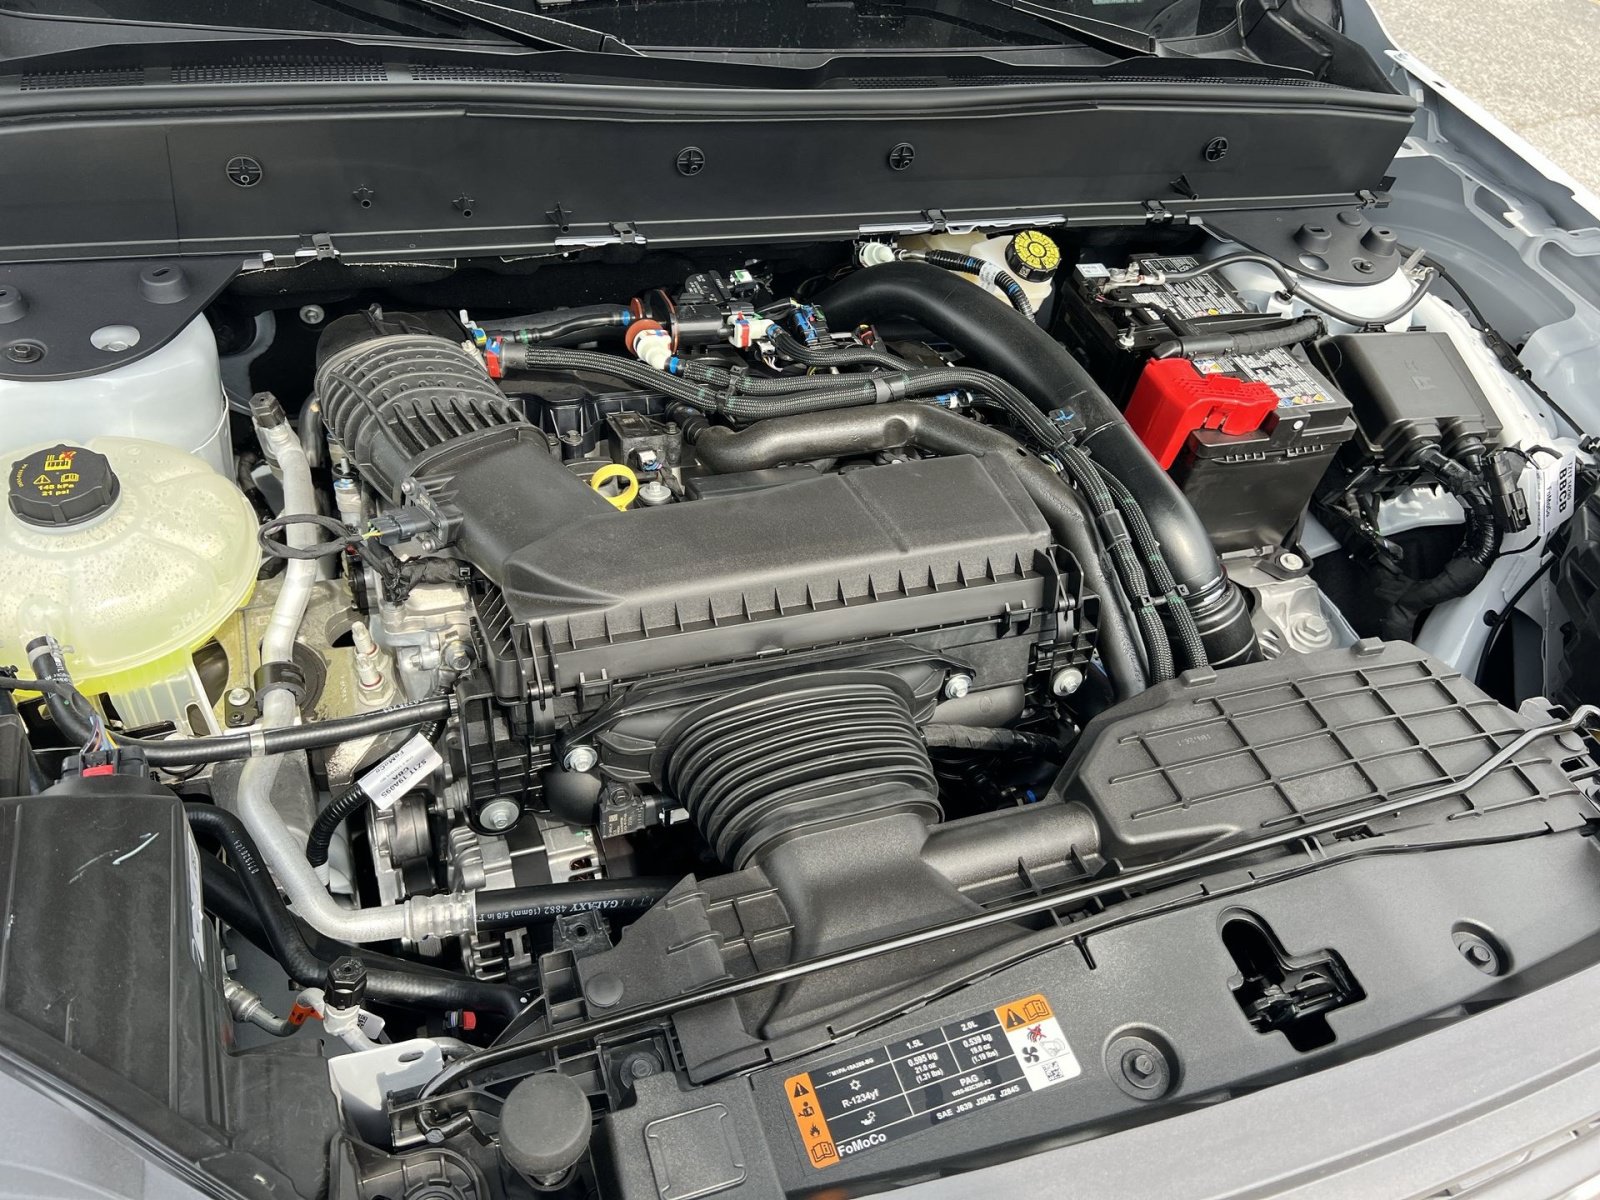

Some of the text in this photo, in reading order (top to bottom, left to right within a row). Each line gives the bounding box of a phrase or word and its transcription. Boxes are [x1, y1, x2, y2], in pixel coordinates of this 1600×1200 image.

[1558, 468, 1568, 514] BBCB
[375, 750, 404, 774] FoMoCo
[544, 905, 567, 914] 4882
[570, 900, 618, 912] GALAXY
[497, 911, 509, 920] 5/8
[511, 908, 541, 917] (16mm)
[960, 1020, 978, 1031] 2.0L
[906, 1039, 924, 1049] 1.5L
[962, 1033, 993, 1048] 0.539 kg
[907, 1052, 938, 1067] 0.595 kg
[986, 1049, 998, 1058] lbs)
[914, 1064, 928, 1074] 21.0
[916, 1068, 944, 1084] (1.31 lbs)
[960, 1074, 979, 1086] PAG
[842, 1088, 879, 1108] R-1234yf
[936, 1085, 1020, 1120] SAE J639 J2842 J2845
[836, 1133, 887, 1157] FoMoCo
